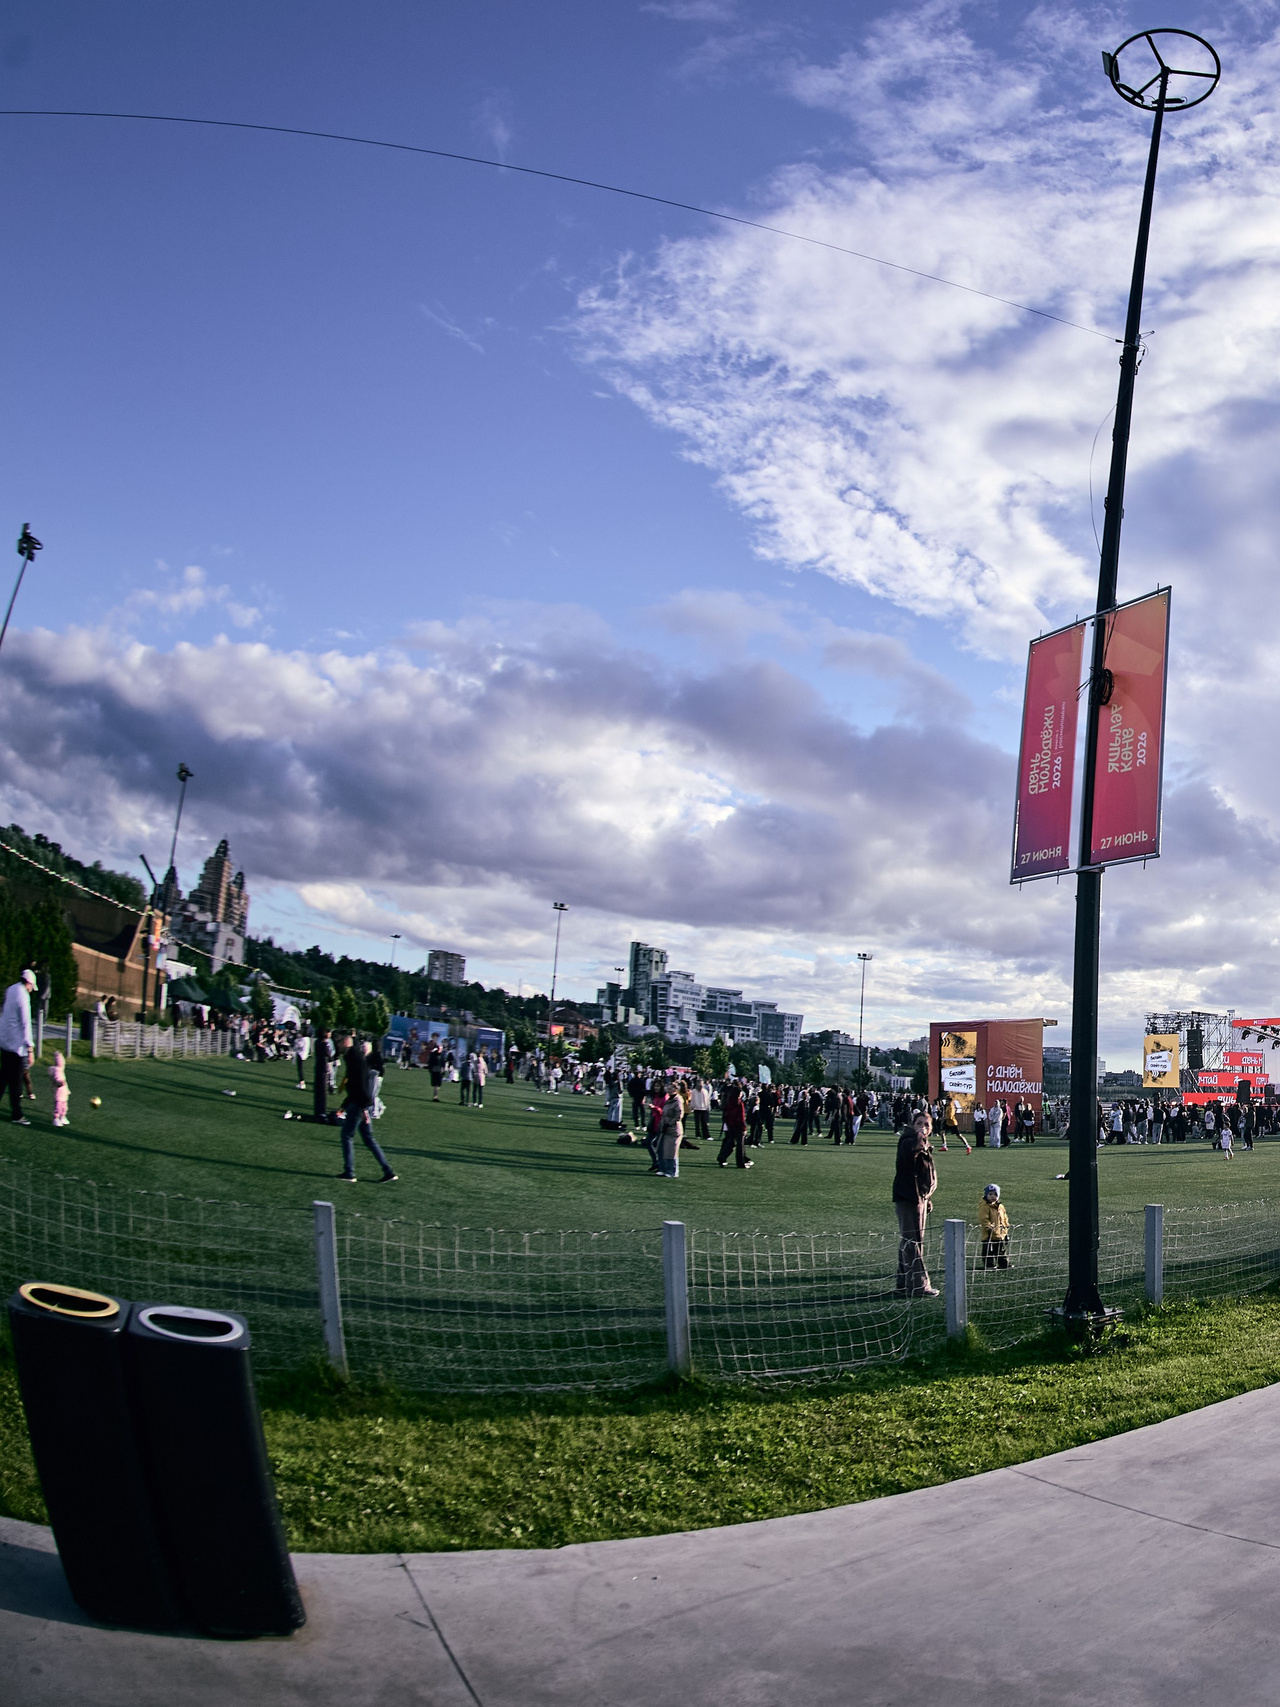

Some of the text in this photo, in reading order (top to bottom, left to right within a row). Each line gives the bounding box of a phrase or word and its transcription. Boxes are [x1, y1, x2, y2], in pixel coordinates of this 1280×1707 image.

[1136, 731, 1147, 767] 2026
[1052, 756, 1062, 789] 2026
[1100, 830, 1149, 850] 27 ИЮНЬ
[1020, 846, 1062, 865] 27 ИЮНЯ
